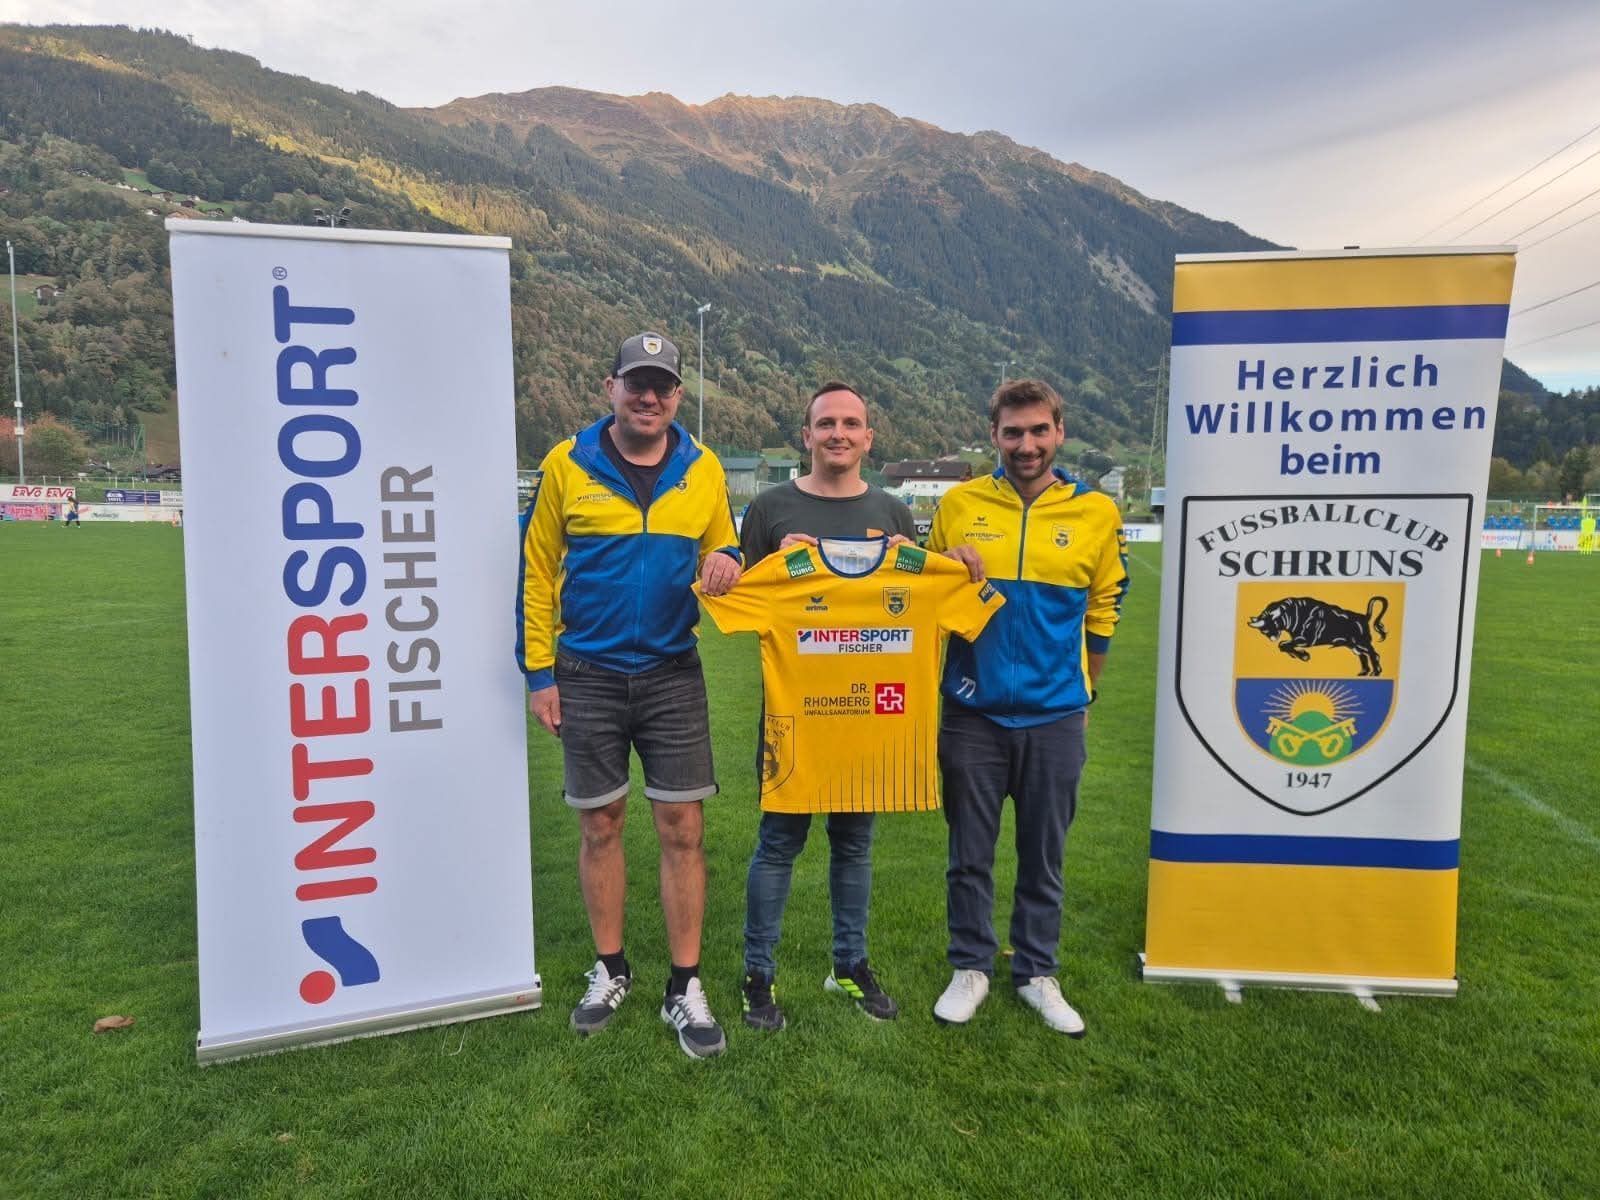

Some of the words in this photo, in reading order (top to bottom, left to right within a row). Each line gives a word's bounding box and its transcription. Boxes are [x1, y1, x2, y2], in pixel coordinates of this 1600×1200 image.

[1236, 353, 1440, 391] Herzlich
[1184, 400, 1487, 435] Willkommen
[1279, 443, 1382, 476] beim
[1195, 502, 1450, 554] FUSSBALLCLUB
[1218, 549, 1424, 578] SCHRUNS
[380, 464, 443, 733] FISCHER
[805, 604, 829, 612] erima
[813, 629, 909, 643] INTERSPORT
[838, 643, 883, 653] FISCHER
[851, 683, 870, 694] DR.
[803, 696, 871, 708] RHOMBERG
[803, 708, 871, 717] UNFALLSANATORIUM
[1284, 770, 1333, 789] 1947
